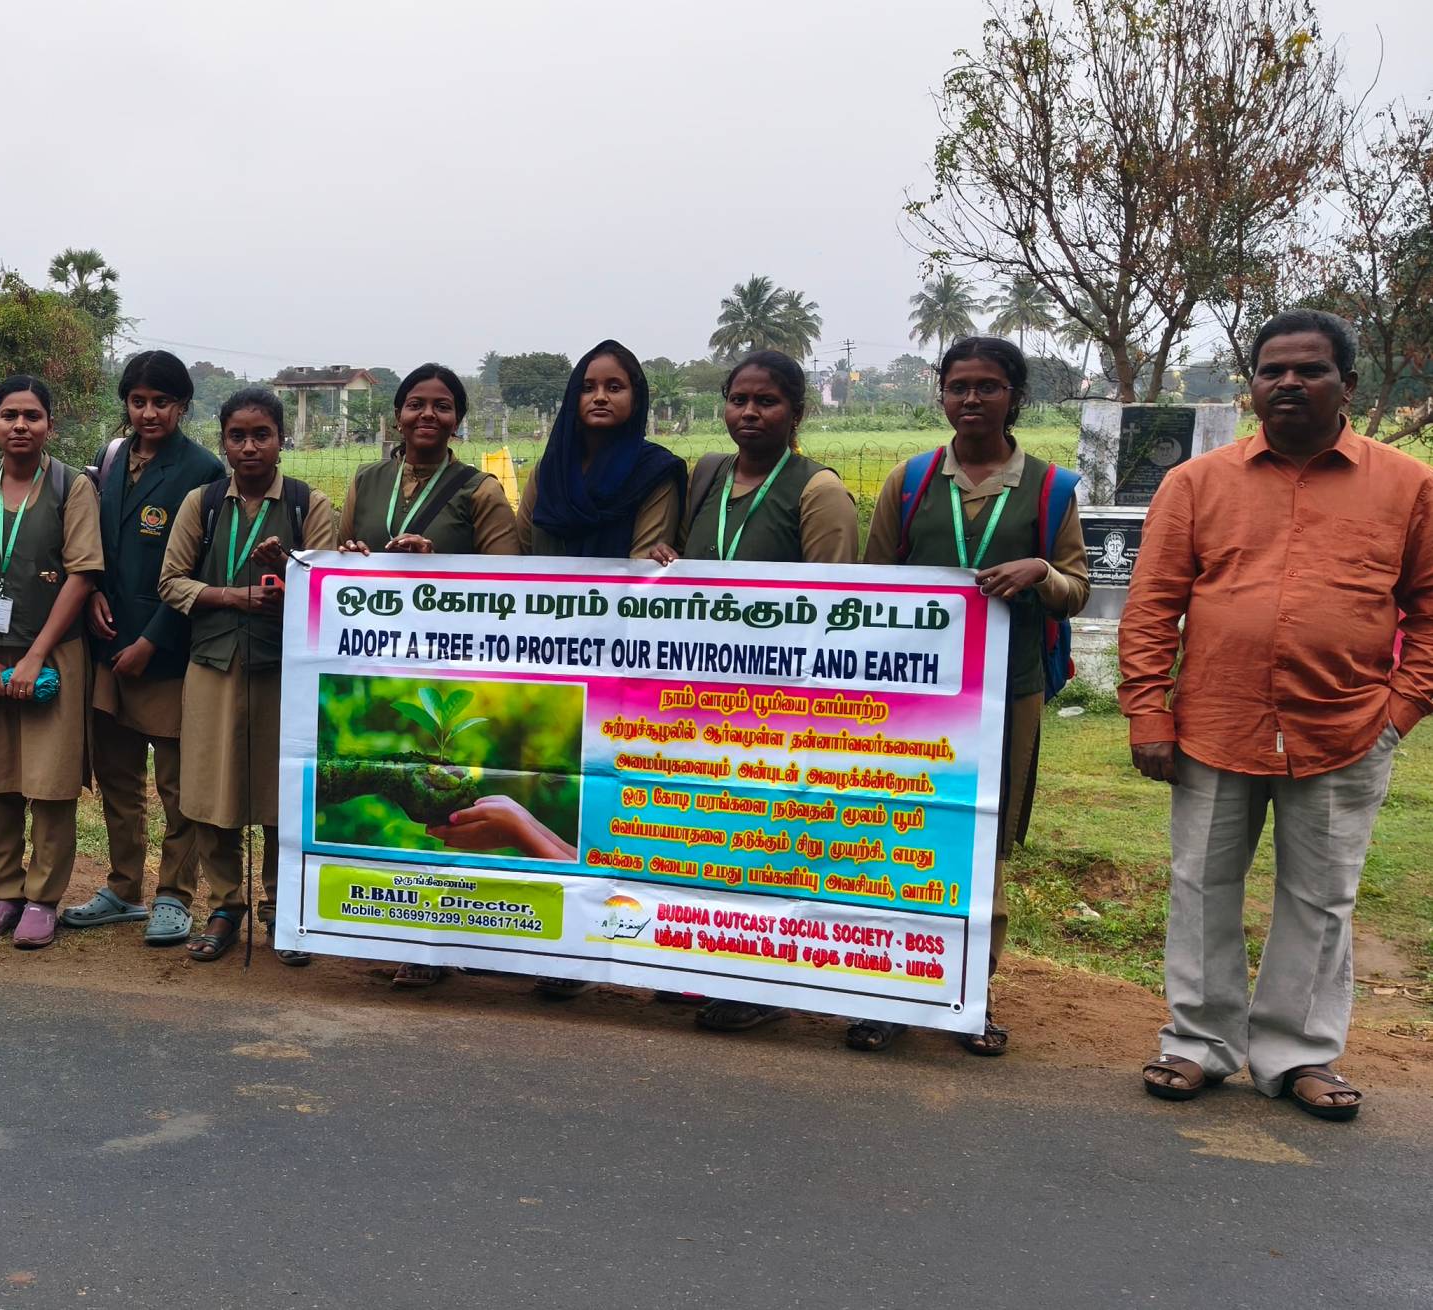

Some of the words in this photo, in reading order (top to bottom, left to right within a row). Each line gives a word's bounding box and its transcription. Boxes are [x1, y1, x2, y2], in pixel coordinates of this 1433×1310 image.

[336, 586, 404, 616] ஒரு
[413, 583, 516, 620] கோடி
[525, 588, 608, 620] மரம்
[617, 591, 817, 628] வளர்க்கும்
[825, 597, 950, 635] திட்டம்
[337, 628, 402, 657] ADOPT
[406, 631, 420, 659] A
[425, 632, 474, 661] TREE
[516, 635, 606, 666] PROTECT
[611, 638, 651, 669] OUR
[656, 640, 807, 677] ENVIRONMENT
[811, 648, 857, 680] AND
[864, 651, 939, 684] EARTH
[661, 687, 695, 708] நாம்
[700, 688, 749, 713] வாழும்
[754, 692, 807, 716] பூமியை
[814, 695, 888, 721] காப்பாற்ற
[602, 716, 697, 742] சுற்றுச்சூழலில்
[703, 723, 784, 747] ஆர்வமுள்ள
[790, 729, 954, 760] தன்னார்வலர்களையும்,
[616, 753, 731, 778] அமைப்புகளையும்
[738, 760, 800, 783] அன்புடன்
[807, 768, 934, 793] அழைக்கின்றோம்.
[622, 788, 646, 806] ஒரு
[653, 788, 690, 810] கோடி
[696, 791, 767, 814] மரங்களை
[773, 801, 836, 821] நடுவதன்
[842, 804, 886, 826] மூலம்
[893, 807, 924, 831] பூமி
[611, 816, 726, 845] வெப்பமயமாதலை
[732, 829, 791, 851] தடுக்கும்
[796, 833, 824, 857] சிறு
[829, 838, 885, 862] முயற்சி.
[893, 848, 934, 868] எமது
[587, 849, 643, 870] இலக்கை
[649, 857, 697, 876] அடைய
[703, 863, 742, 884] உமது
[748, 864, 818, 891] பங்களிப்பு
[825, 874, 895, 899] அவசியம்,
[901, 881, 944, 903] வாரீர்
[341, 903, 385, 918] Mobile:
[389, 907, 464, 926] 6369979299,
[467, 914, 542, 931] 9486171442
[350, 885, 419, 905] R.BALU
[440, 896, 535, 916] Director,
[654, 925, 693, 949] புத்தர்
[802, 946, 840, 968] சமூக
[844, 948, 892, 972] சங்கம்
[906, 957, 944, 979] பாஸ்
[656, 903, 711, 926] BUDDHA
[714, 909, 776, 933] OUTCAST
[779, 917, 829, 941] SOCIAL
[832, 923, 894, 948] SOCIETY
[905, 932, 945, 955] BOSS
